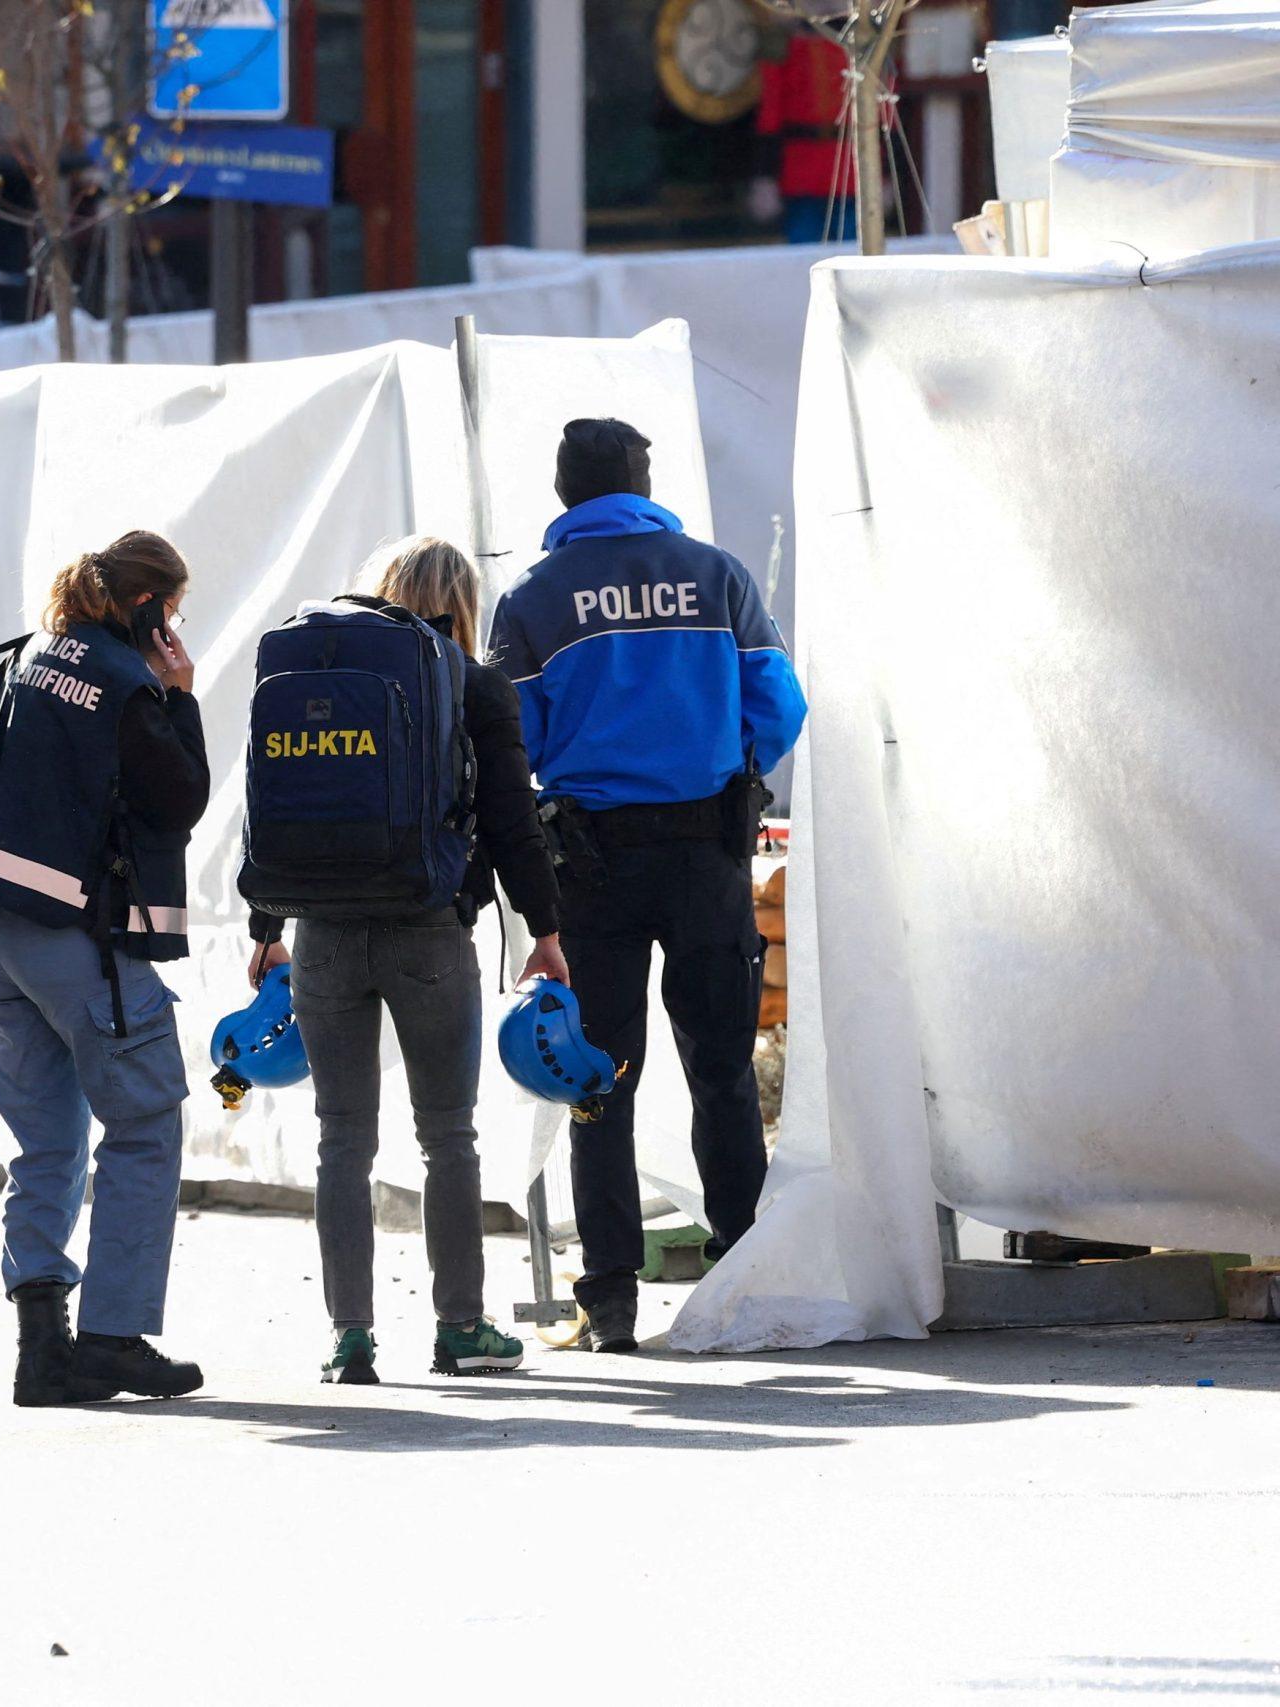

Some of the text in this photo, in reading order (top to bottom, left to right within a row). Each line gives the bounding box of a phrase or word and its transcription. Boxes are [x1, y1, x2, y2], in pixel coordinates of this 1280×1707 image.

[573, 582, 700, 625] POLICE
[46, 634, 90, 665] LICE
[265, 729, 377, 759] SIJ-KTA
